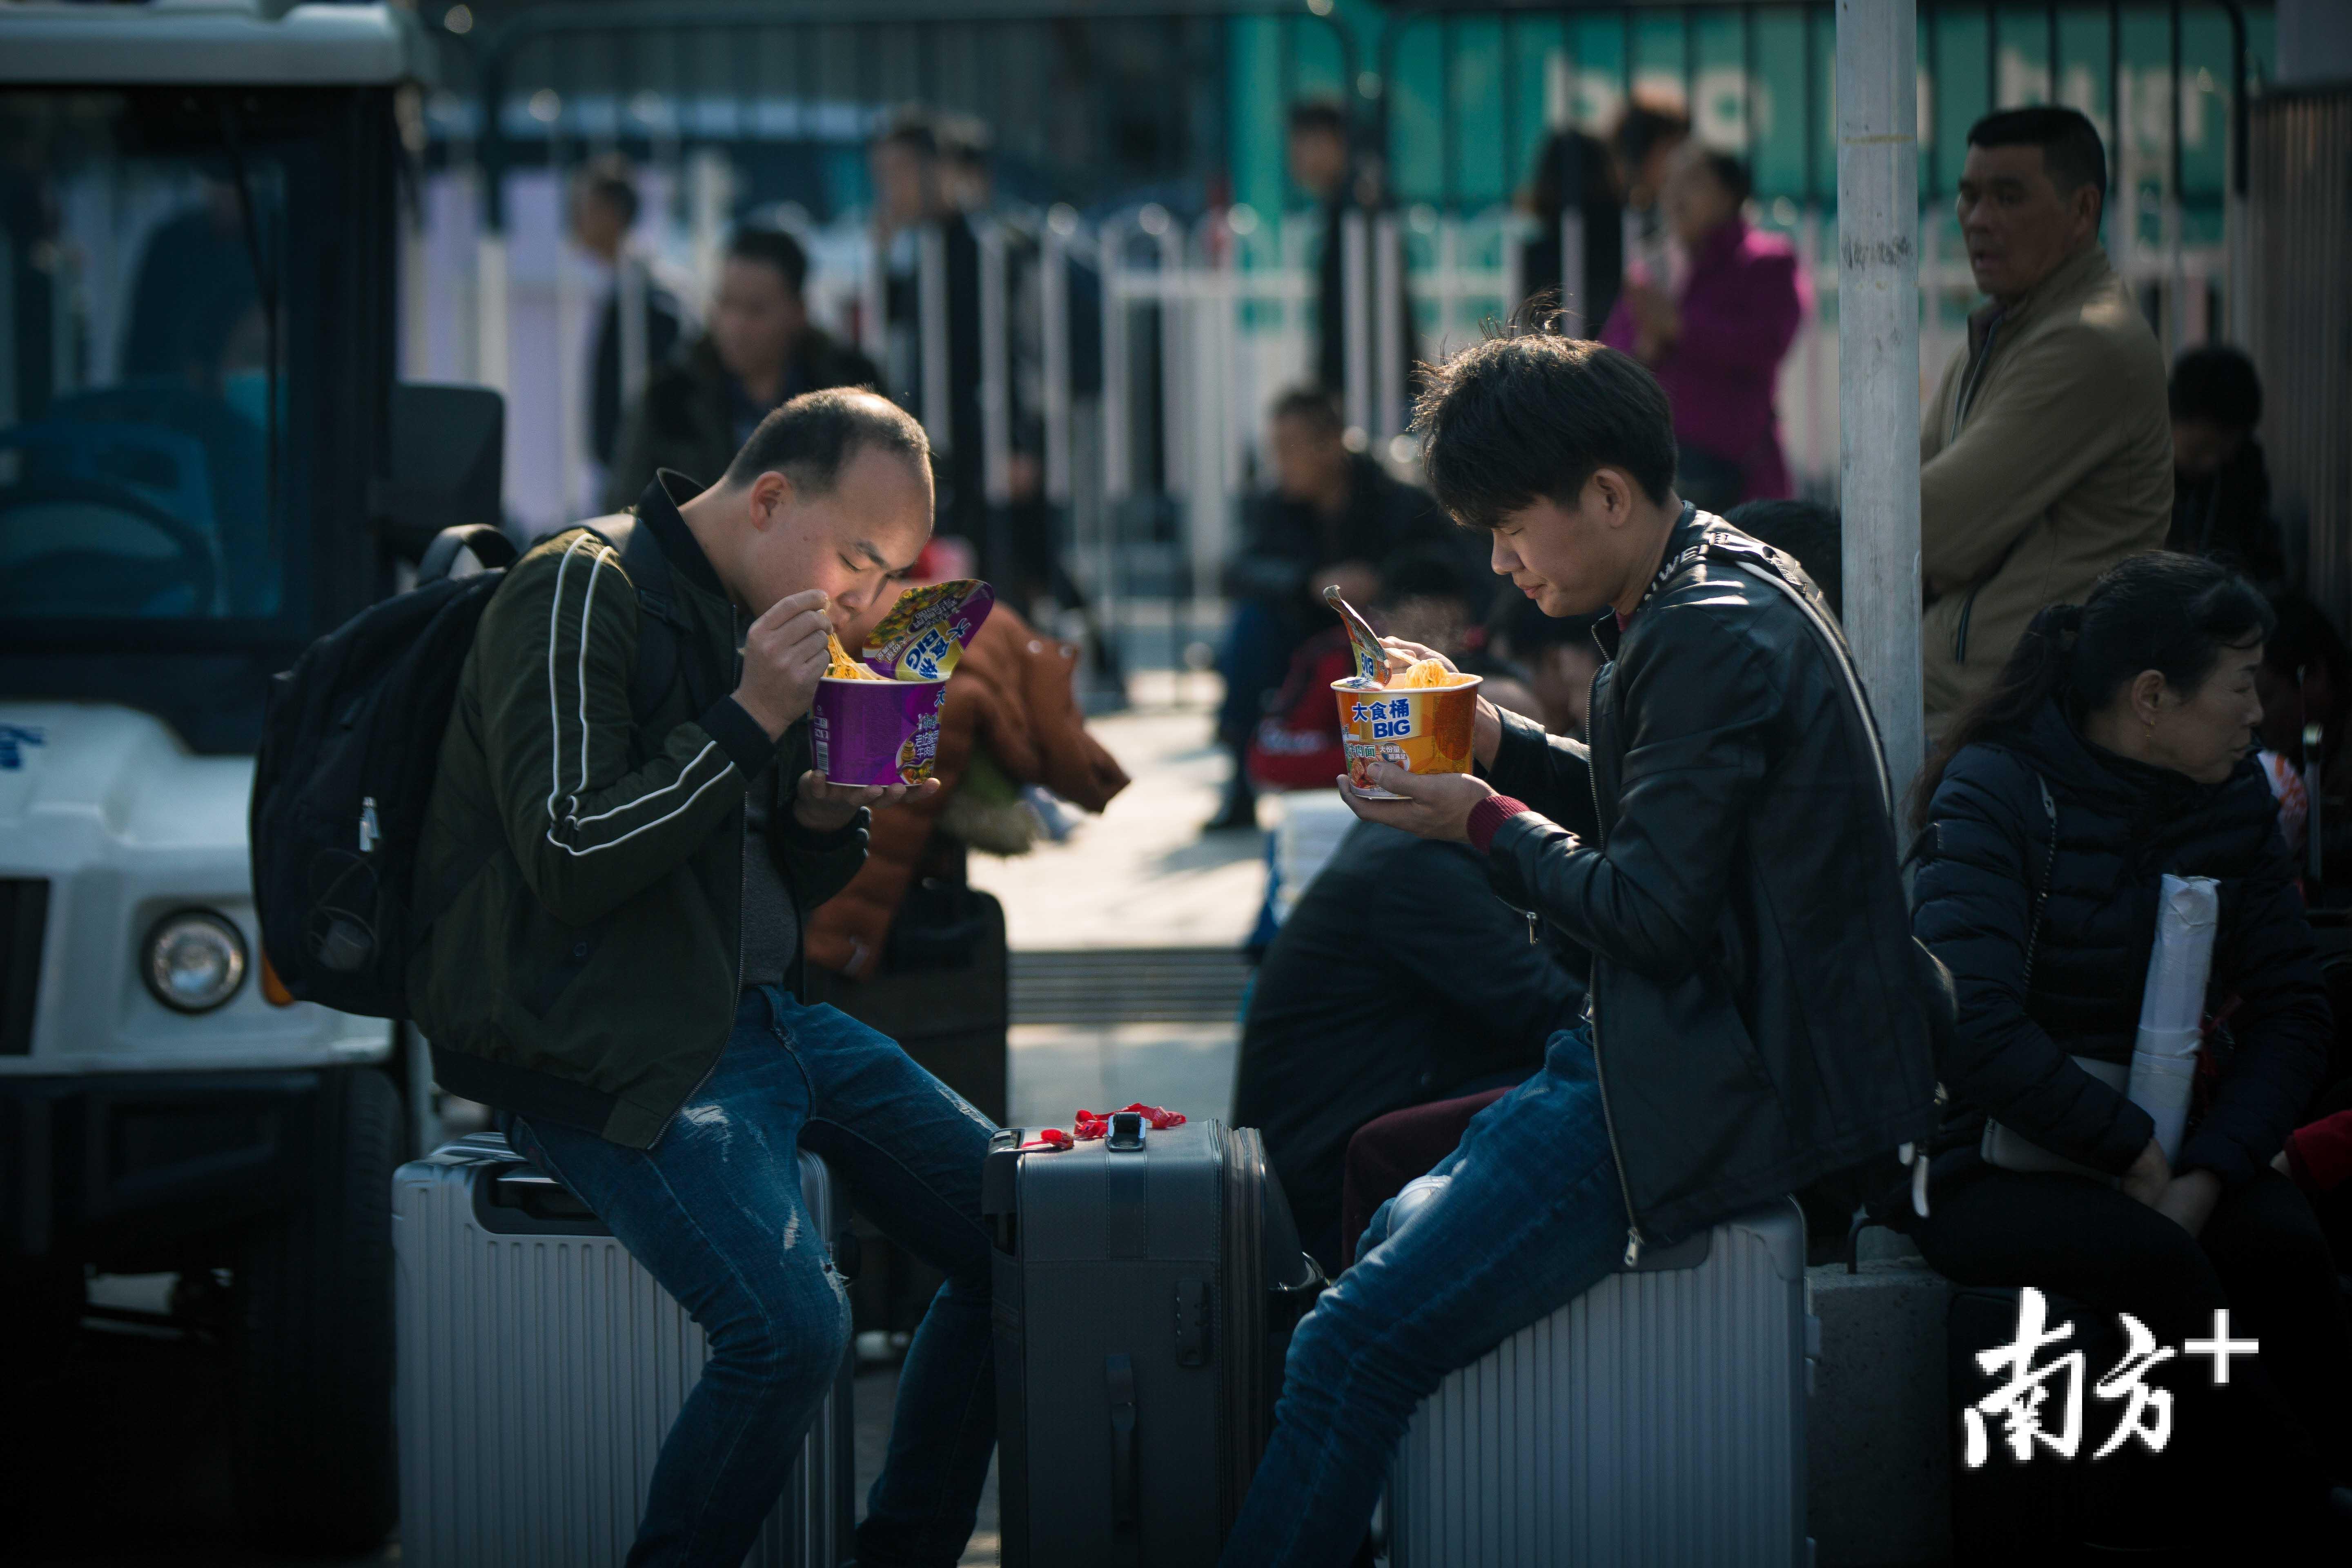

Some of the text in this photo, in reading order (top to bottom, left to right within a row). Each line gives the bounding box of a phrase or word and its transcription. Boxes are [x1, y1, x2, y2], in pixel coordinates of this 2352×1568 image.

[905, 628, 940, 670] BIG
[918, 618, 971, 679] 大食桶
[1352, 697, 1410, 722] 大食桶
[1372, 719, 1411, 739] BIG
[917, 744, 936, 758] 牛肉面
